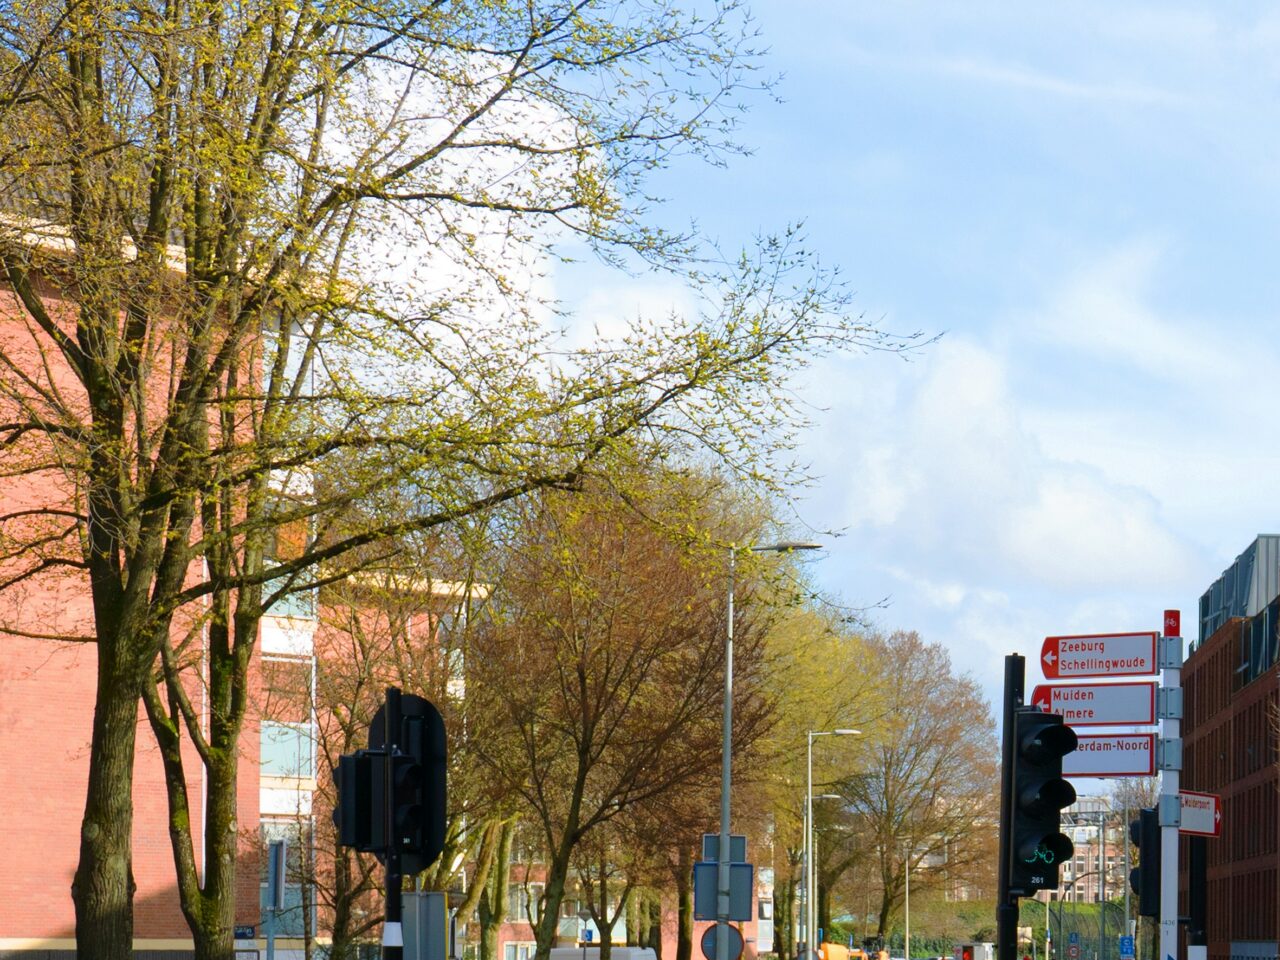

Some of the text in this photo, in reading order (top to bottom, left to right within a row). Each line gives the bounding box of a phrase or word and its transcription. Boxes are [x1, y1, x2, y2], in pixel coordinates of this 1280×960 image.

[1061, 642, 1105, 653] Zeeburg
[1060, 657, 1145, 671] Schellingwoude
[1053, 690, 1094, 700] Muiden
[1031, 876, 1044, 884] 261
